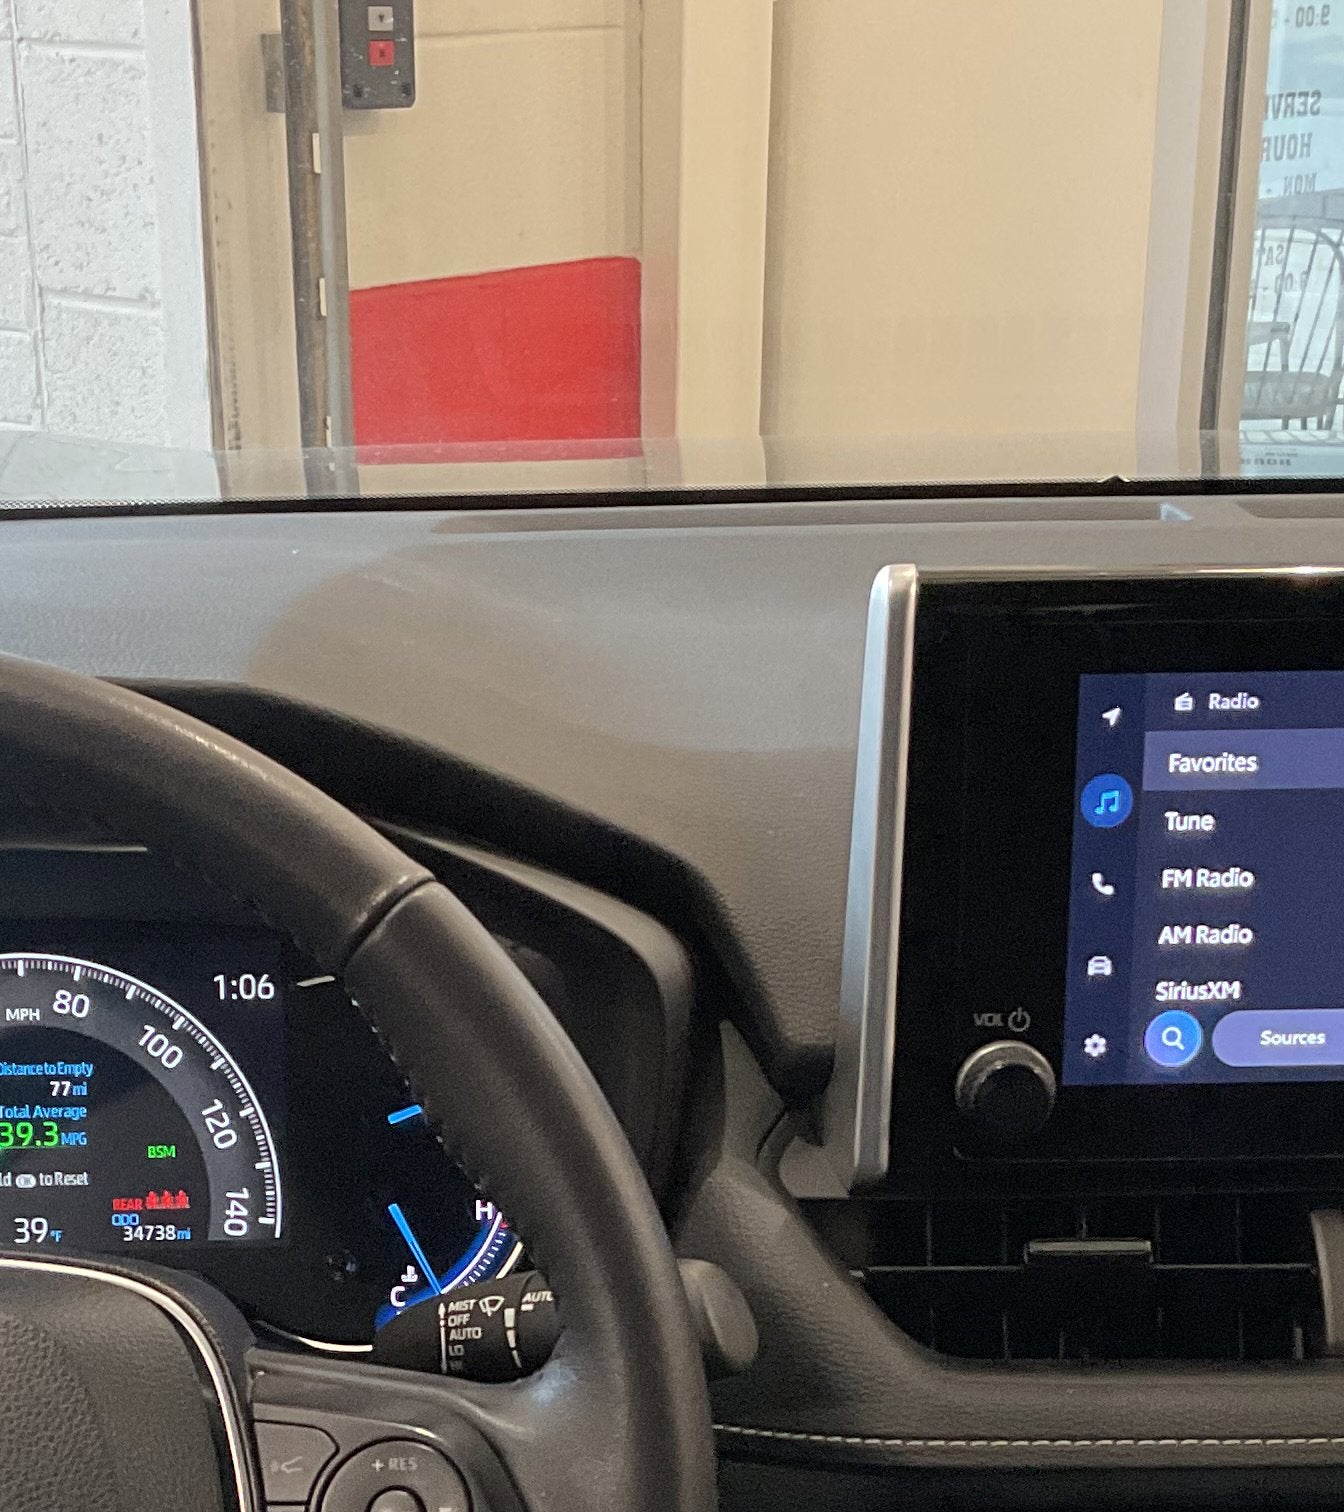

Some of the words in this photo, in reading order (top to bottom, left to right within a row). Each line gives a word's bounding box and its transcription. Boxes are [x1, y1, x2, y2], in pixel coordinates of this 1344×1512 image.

[1208, 692, 1260, 712] Radio
[1168, 752, 1259, 774] Favorites
[1164, 811, 1216, 832] Tune
[1161, 869, 1192, 889] FM
[1196, 867, 1256, 889] Radio
[1158, 926, 1192, 945] AM
[1196, 924, 1254, 945] Radio
[213, 973, 276, 1001] 1:06
[1155, 980, 1242, 1001] SiriusXM
[52, 989, 90, 1018] 80
[5, 1007, 41, 1022] MPH
[973, 1012, 1004, 1026] VOL
[136, 1024, 184, 1070] 100
[1260, 1030, 1326, 1047] Sources
[44, 1062, 56, 1075] to
[57, 1061, 95, 1078] Empty
[49, 1080, 71, 1097] 77
[72, 1081, 88, 1096] mi
[32, 1105, 88, 1121] Average
[201, 1098, 238, 1150] 120
[60, 1131, 88, 1146] MPG
[147, 1145, 176, 1159] BSM
[39, 1173, 53, 1186] to
[54, 1171, 89, 1187] Reset
[112, 1197, 143, 1211] REAR
[222, 1187, 250, 1237] 140
[474, 1199, 493, 1220] H
[111, 1213, 140, 1226] ODO
[13, 1217, 49, 1244] 39
[122, 1224, 176, 1242] 34738
[176, 1227, 192, 1241] mi
[389, 1285, 406, 1307] C
[447, 1299, 476, 1313] MIST
[447, 1313, 471, 1327] OFF
[449, 1326, 482, 1340] AUTO
[388, 1457, 418, 1472] RES
